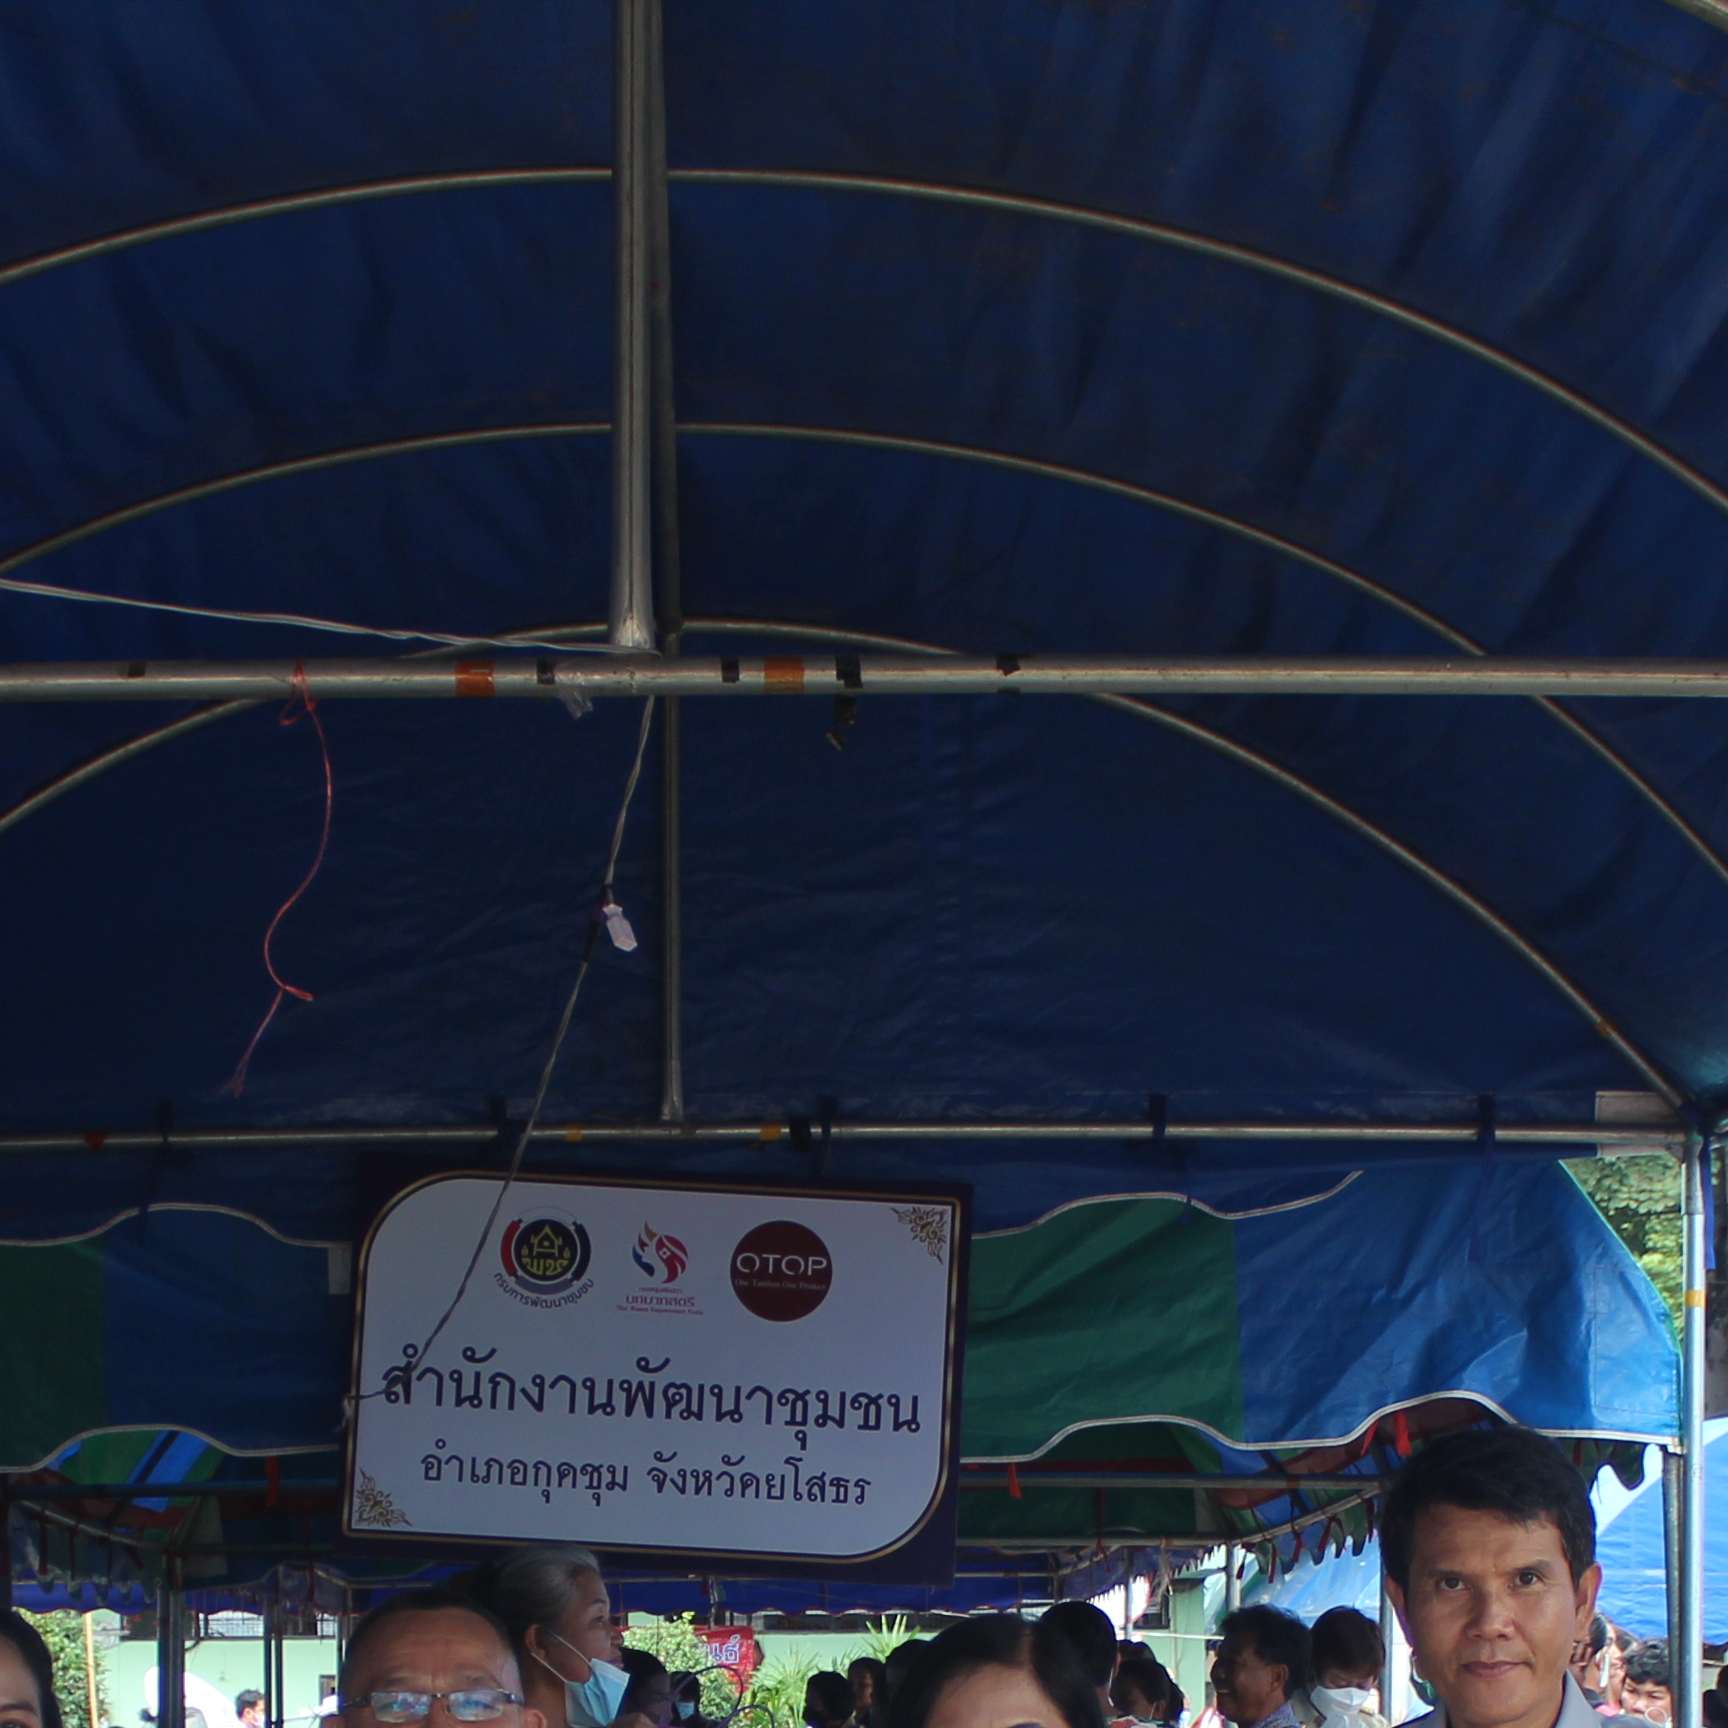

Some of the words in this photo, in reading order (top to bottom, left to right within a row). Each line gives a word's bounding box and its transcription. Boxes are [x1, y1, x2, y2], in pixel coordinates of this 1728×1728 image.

[736, 1252, 828, 1276] OTOP
[382, 1342, 922, 1451] สำนักงานพัฒนาชุมชน
[421, 1439, 629, 1507] อำเภอกุดชุม
[647, 1450, 871, 1505] จังหวัดยโสธร
